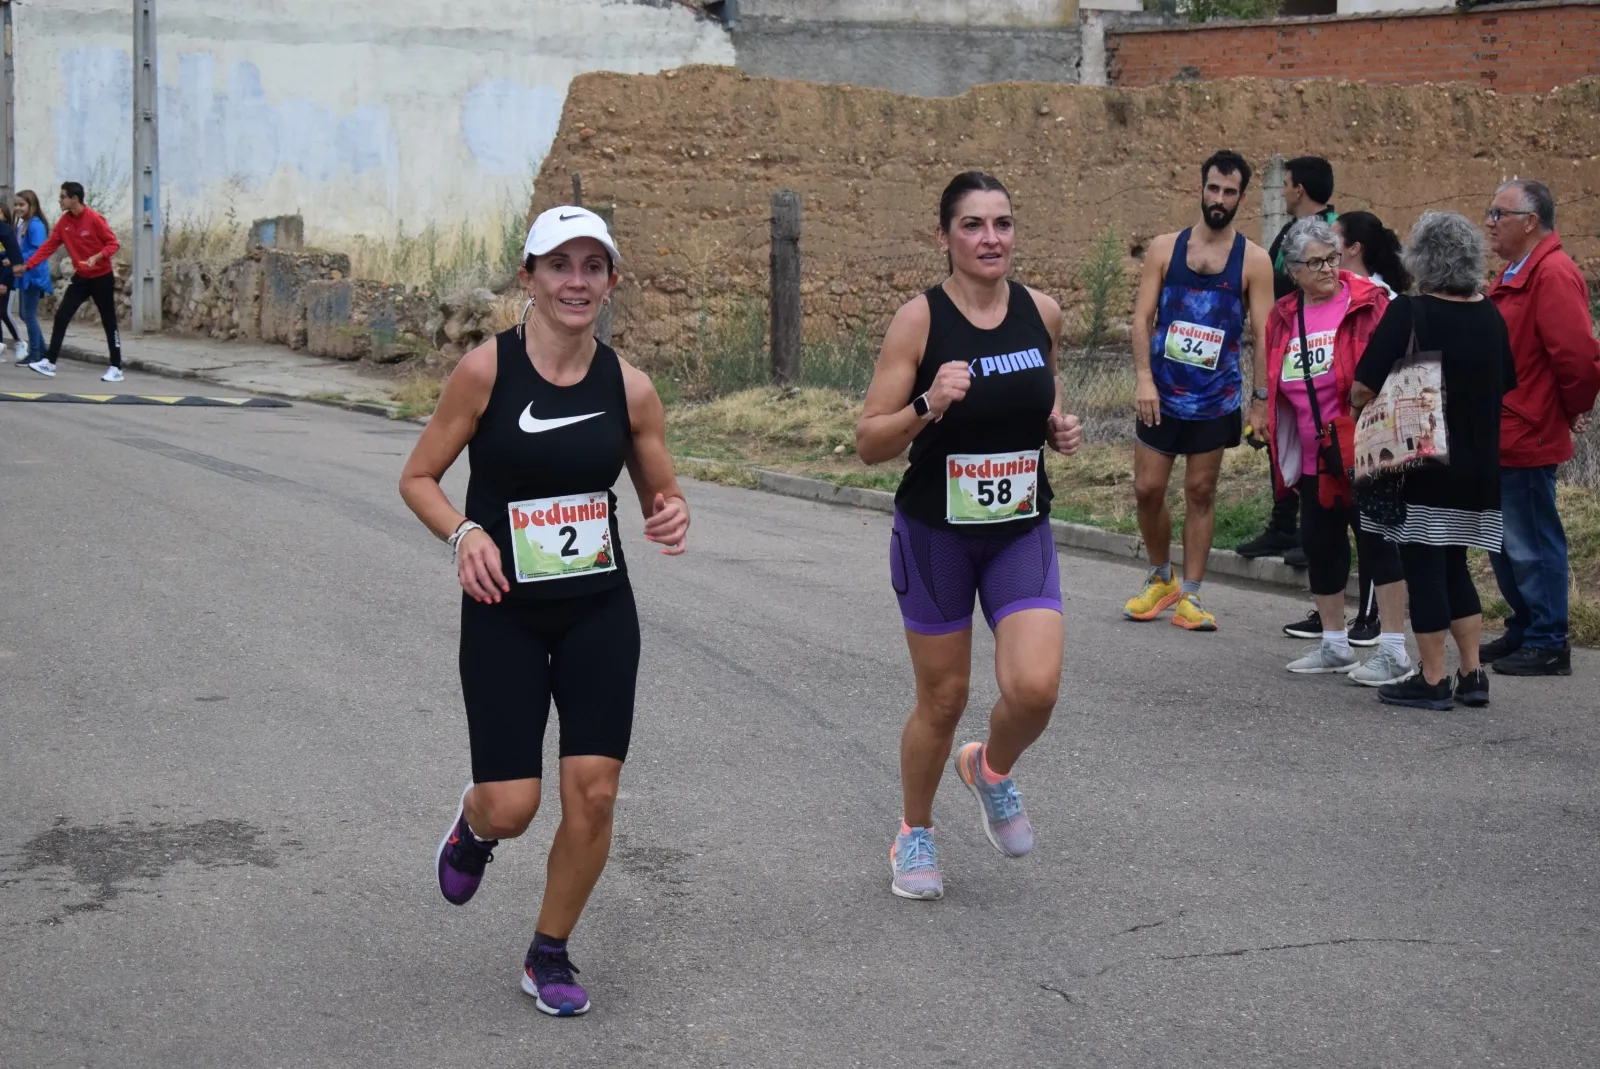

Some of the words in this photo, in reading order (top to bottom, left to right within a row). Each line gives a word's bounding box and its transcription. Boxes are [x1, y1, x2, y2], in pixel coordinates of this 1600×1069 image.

[1170, 323, 1222, 344] bedunia
[1181, 337, 1203, 356] 34
[980, 348, 1045, 376] PUMA
[949, 456, 1036, 479] bedunia
[977, 478, 1012, 507] 58
[511, 499, 607, 530] bedunia
[559, 525, 579, 557] 2
